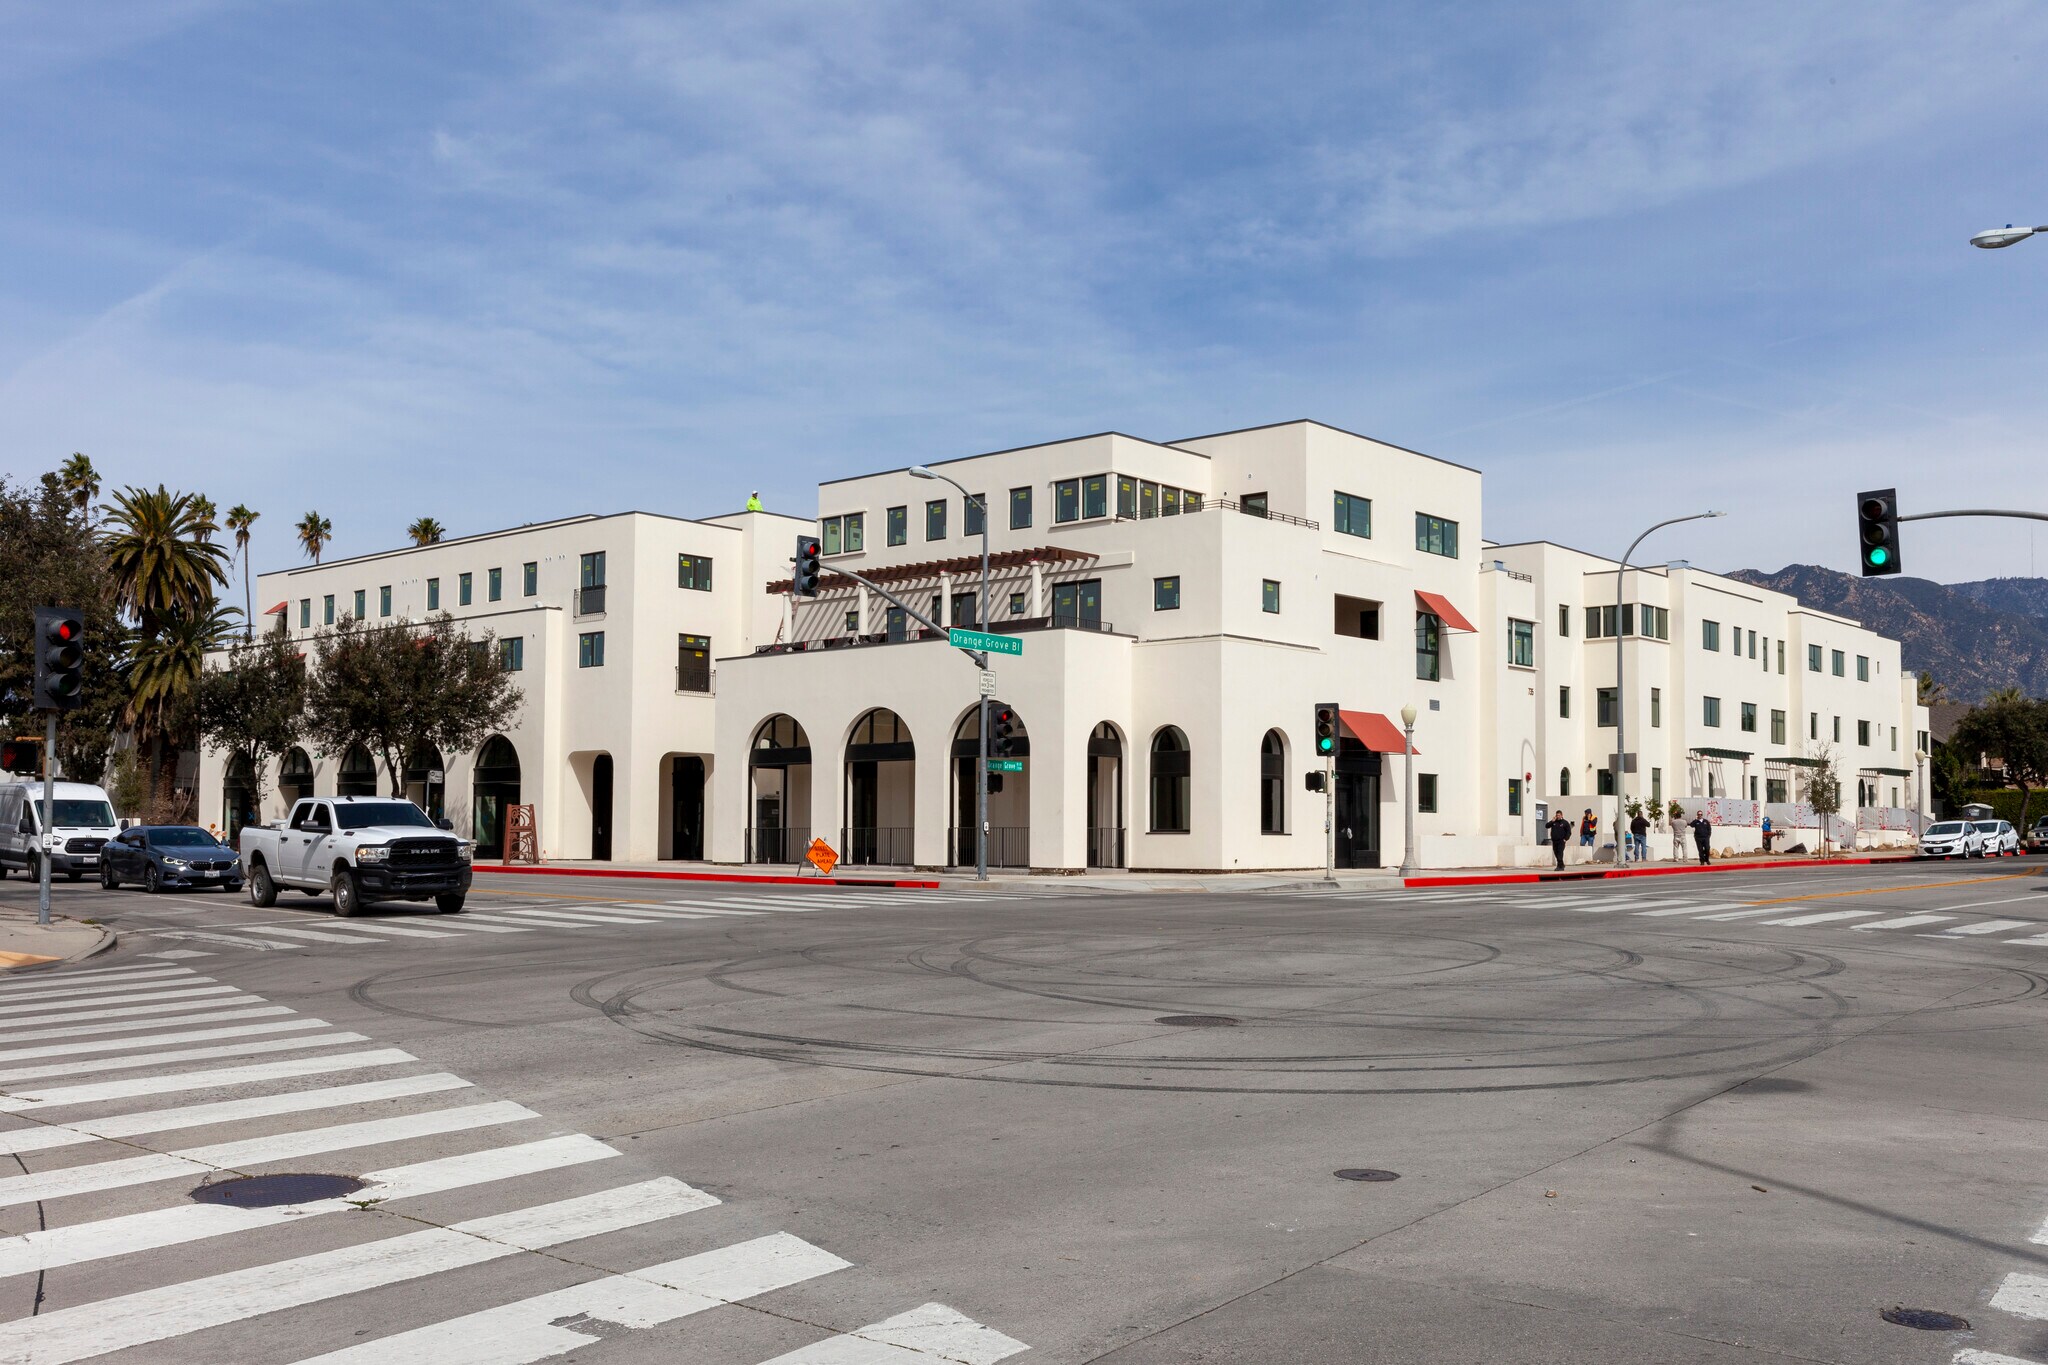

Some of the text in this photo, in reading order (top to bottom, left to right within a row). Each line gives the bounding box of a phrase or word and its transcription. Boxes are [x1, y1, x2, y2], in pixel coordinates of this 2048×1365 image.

[953, 633, 1020, 651] Orange Grove Bl
